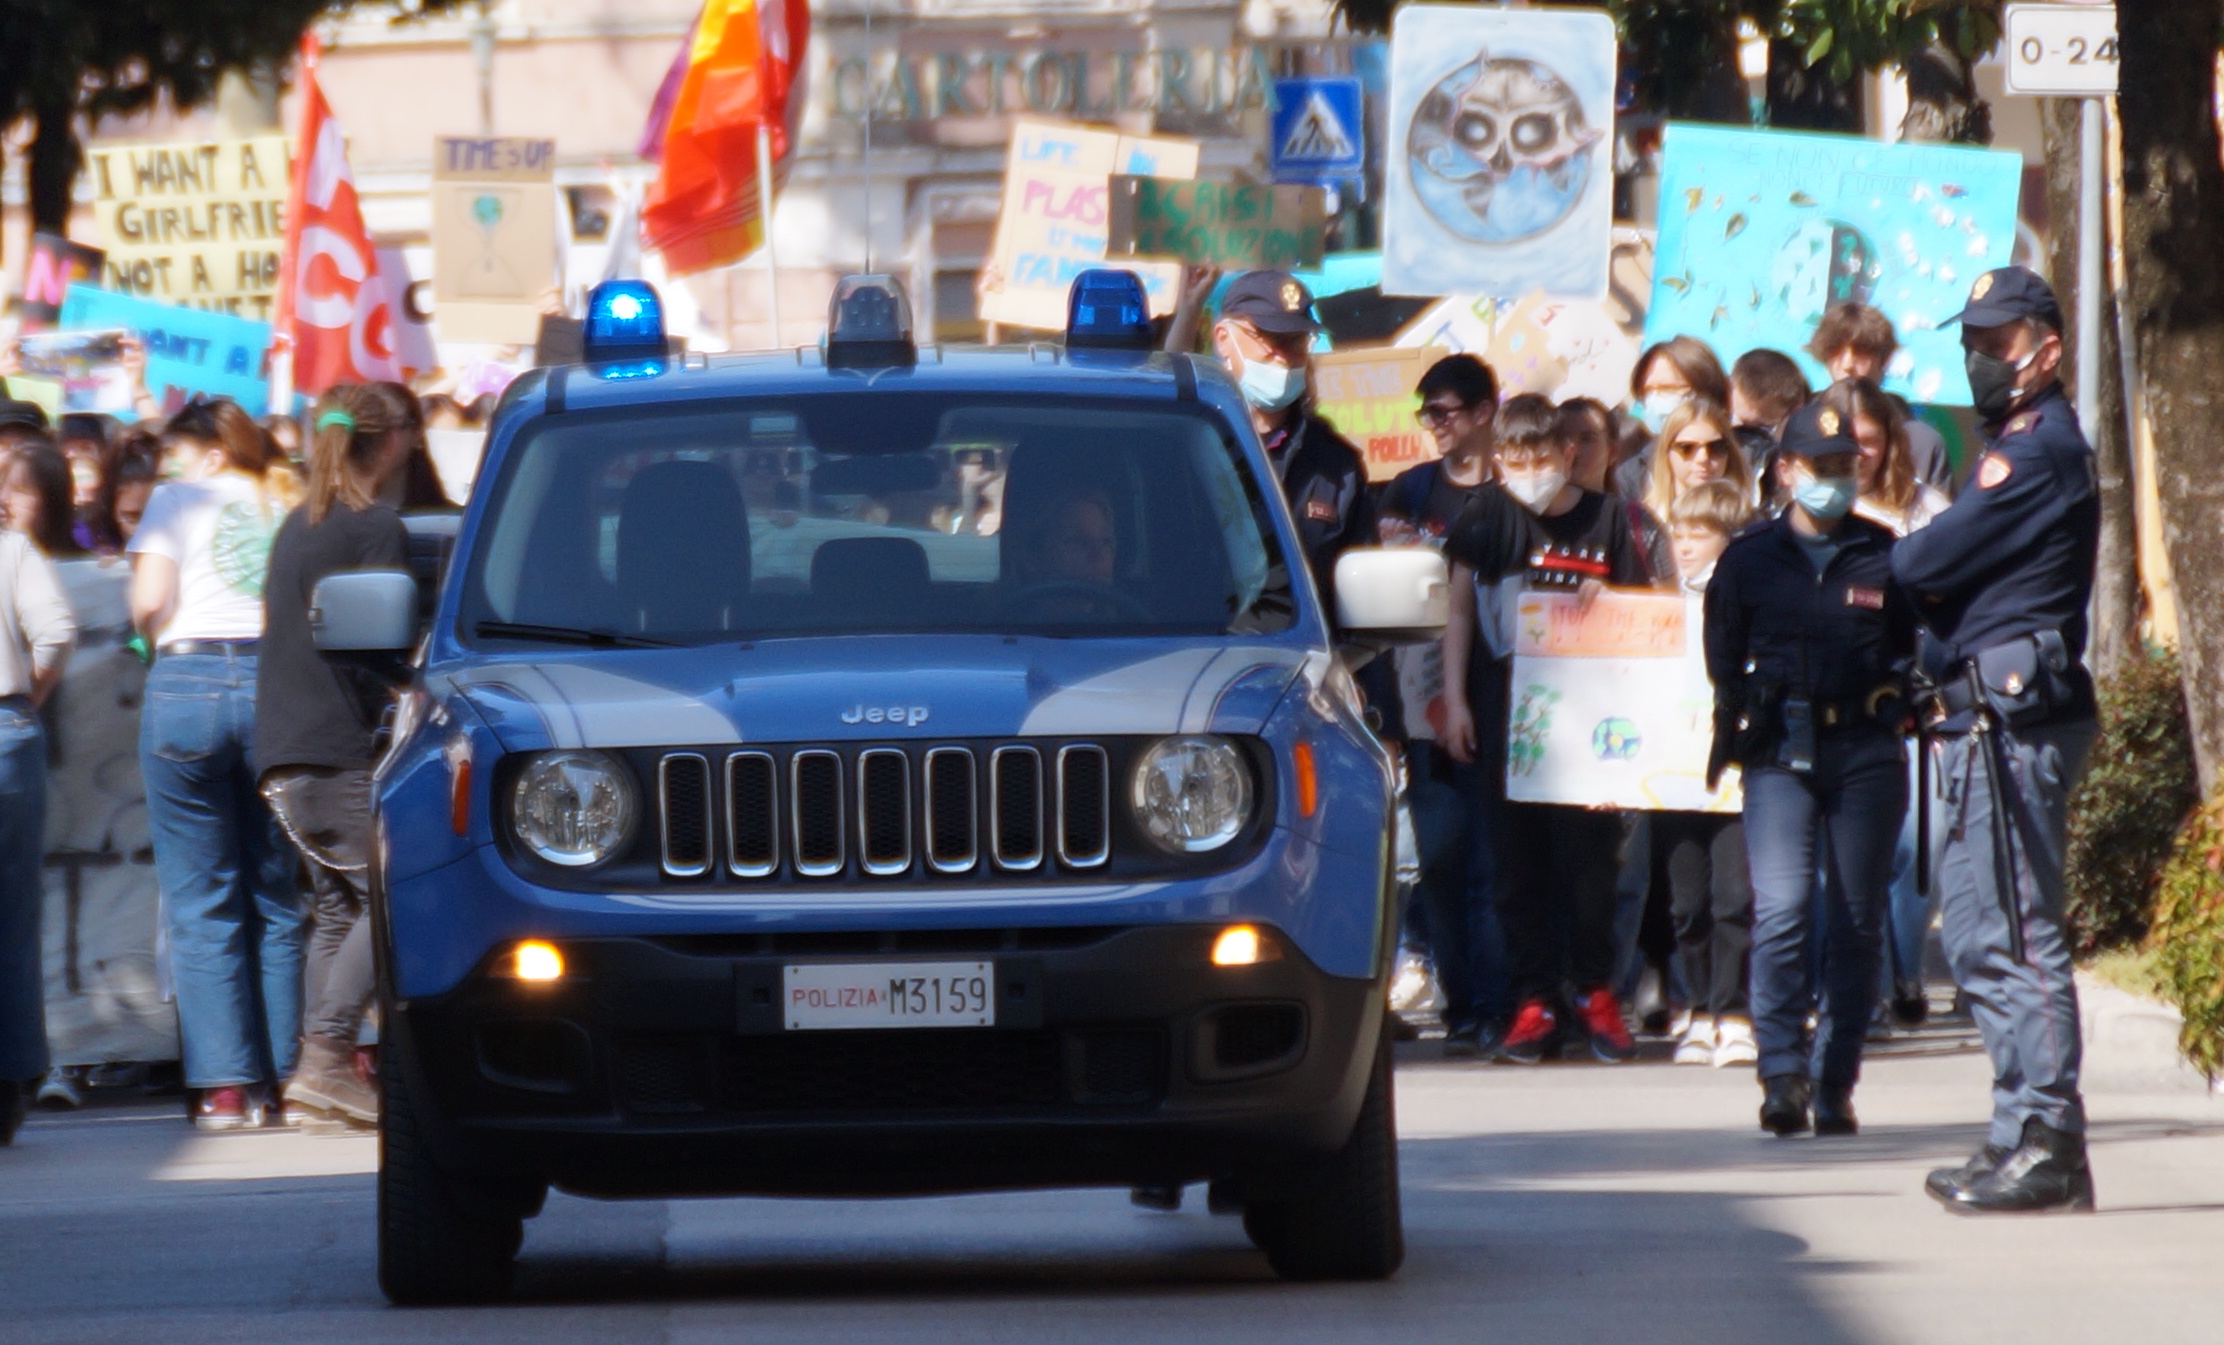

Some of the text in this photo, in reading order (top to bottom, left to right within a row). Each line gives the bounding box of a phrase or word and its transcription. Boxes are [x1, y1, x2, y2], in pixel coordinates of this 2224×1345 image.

[832, 44, 1281, 121] CARTOLERIA
[93, 154, 115, 199] I
[129, 145, 220, 197] WANT
[239, 143, 266, 190] A
[524, 141, 555, 172] UP
[106, 256, 172, 295] NOT
[191, 253, 214, 292] A
[841, 703, 929, 727] Jeep
[792, 976, 987, 1015] POLIZIA M3159
